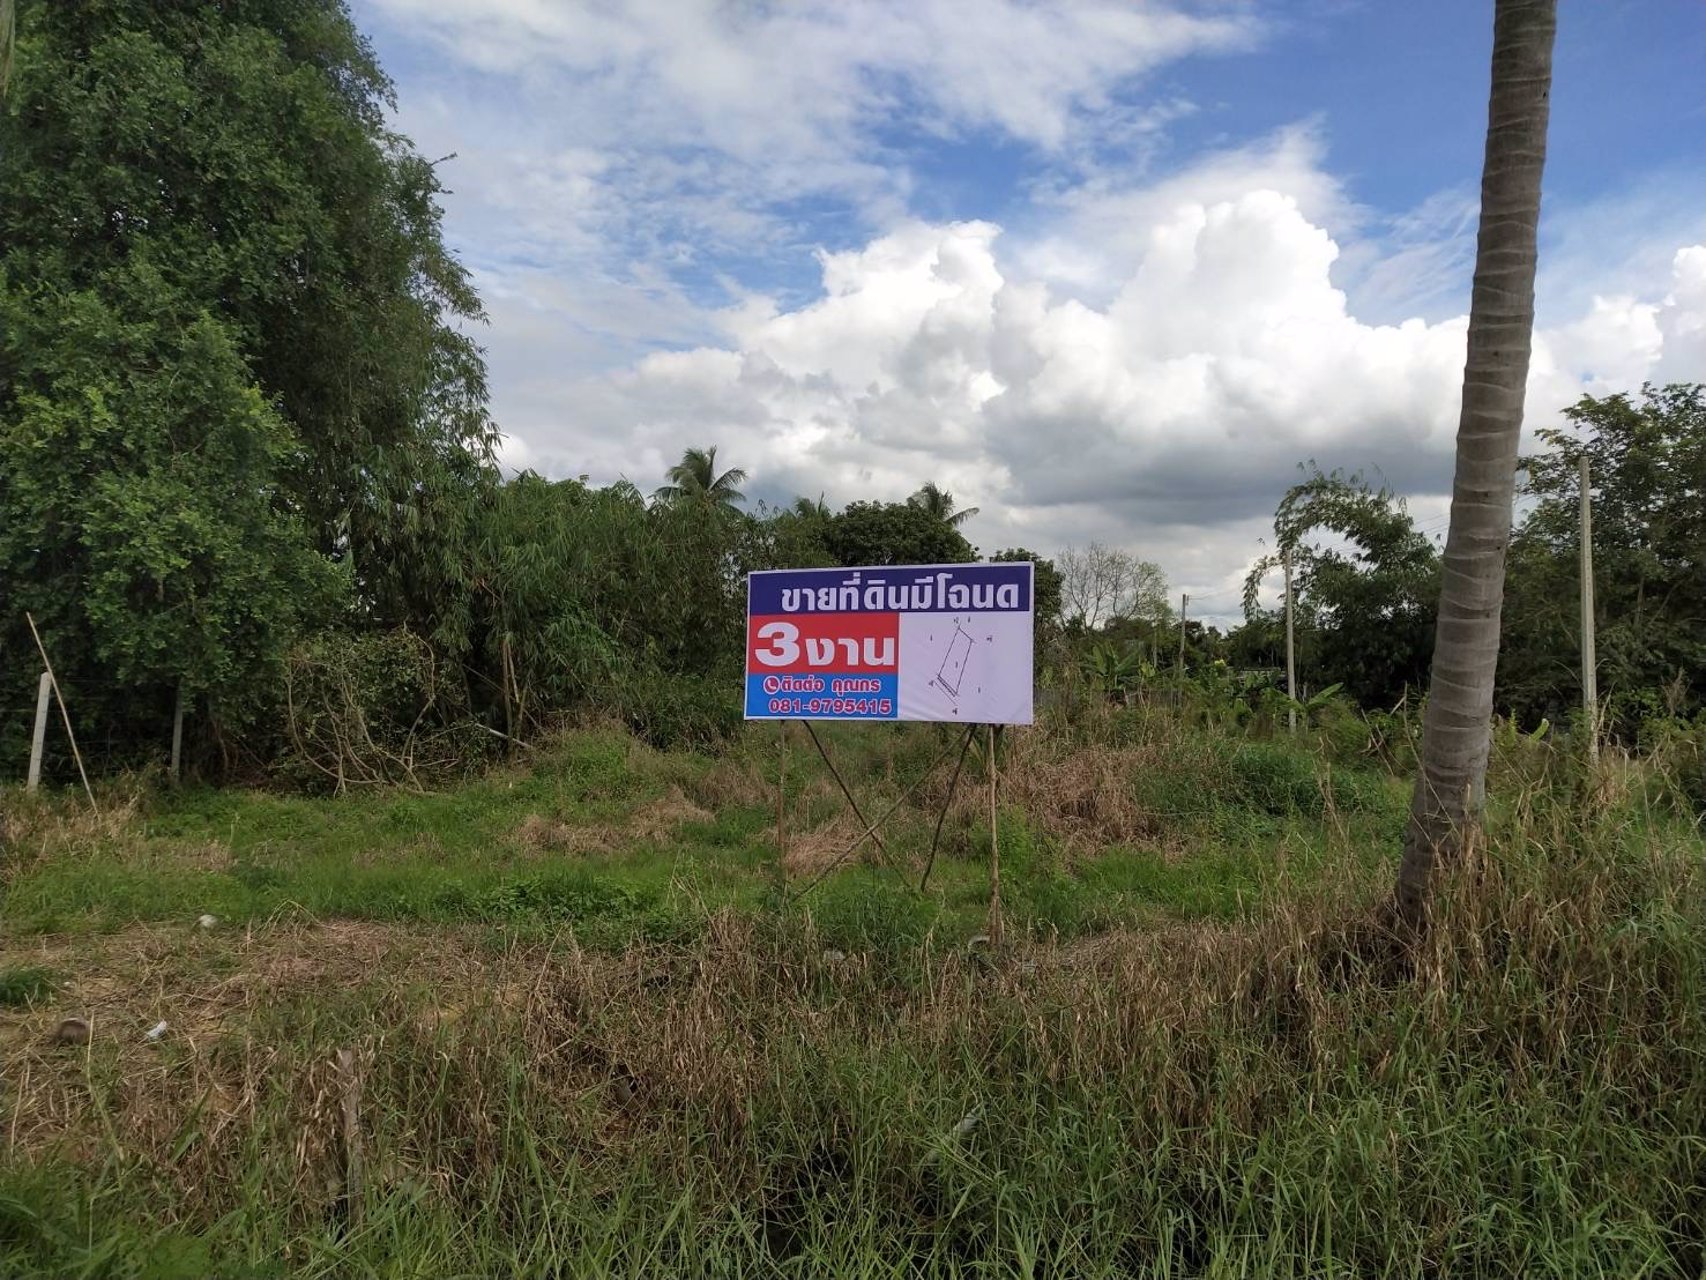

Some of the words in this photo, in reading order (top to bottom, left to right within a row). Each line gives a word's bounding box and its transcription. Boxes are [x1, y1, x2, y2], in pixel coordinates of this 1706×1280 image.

[781, 572, 1019, 611] ขายที่ดินมีโฉนด
[781, 675, 825, 693] ติดต่อ
[832, 678, 881, 696] คุณกร
[769, 698, 892, 714] 081-9795415
